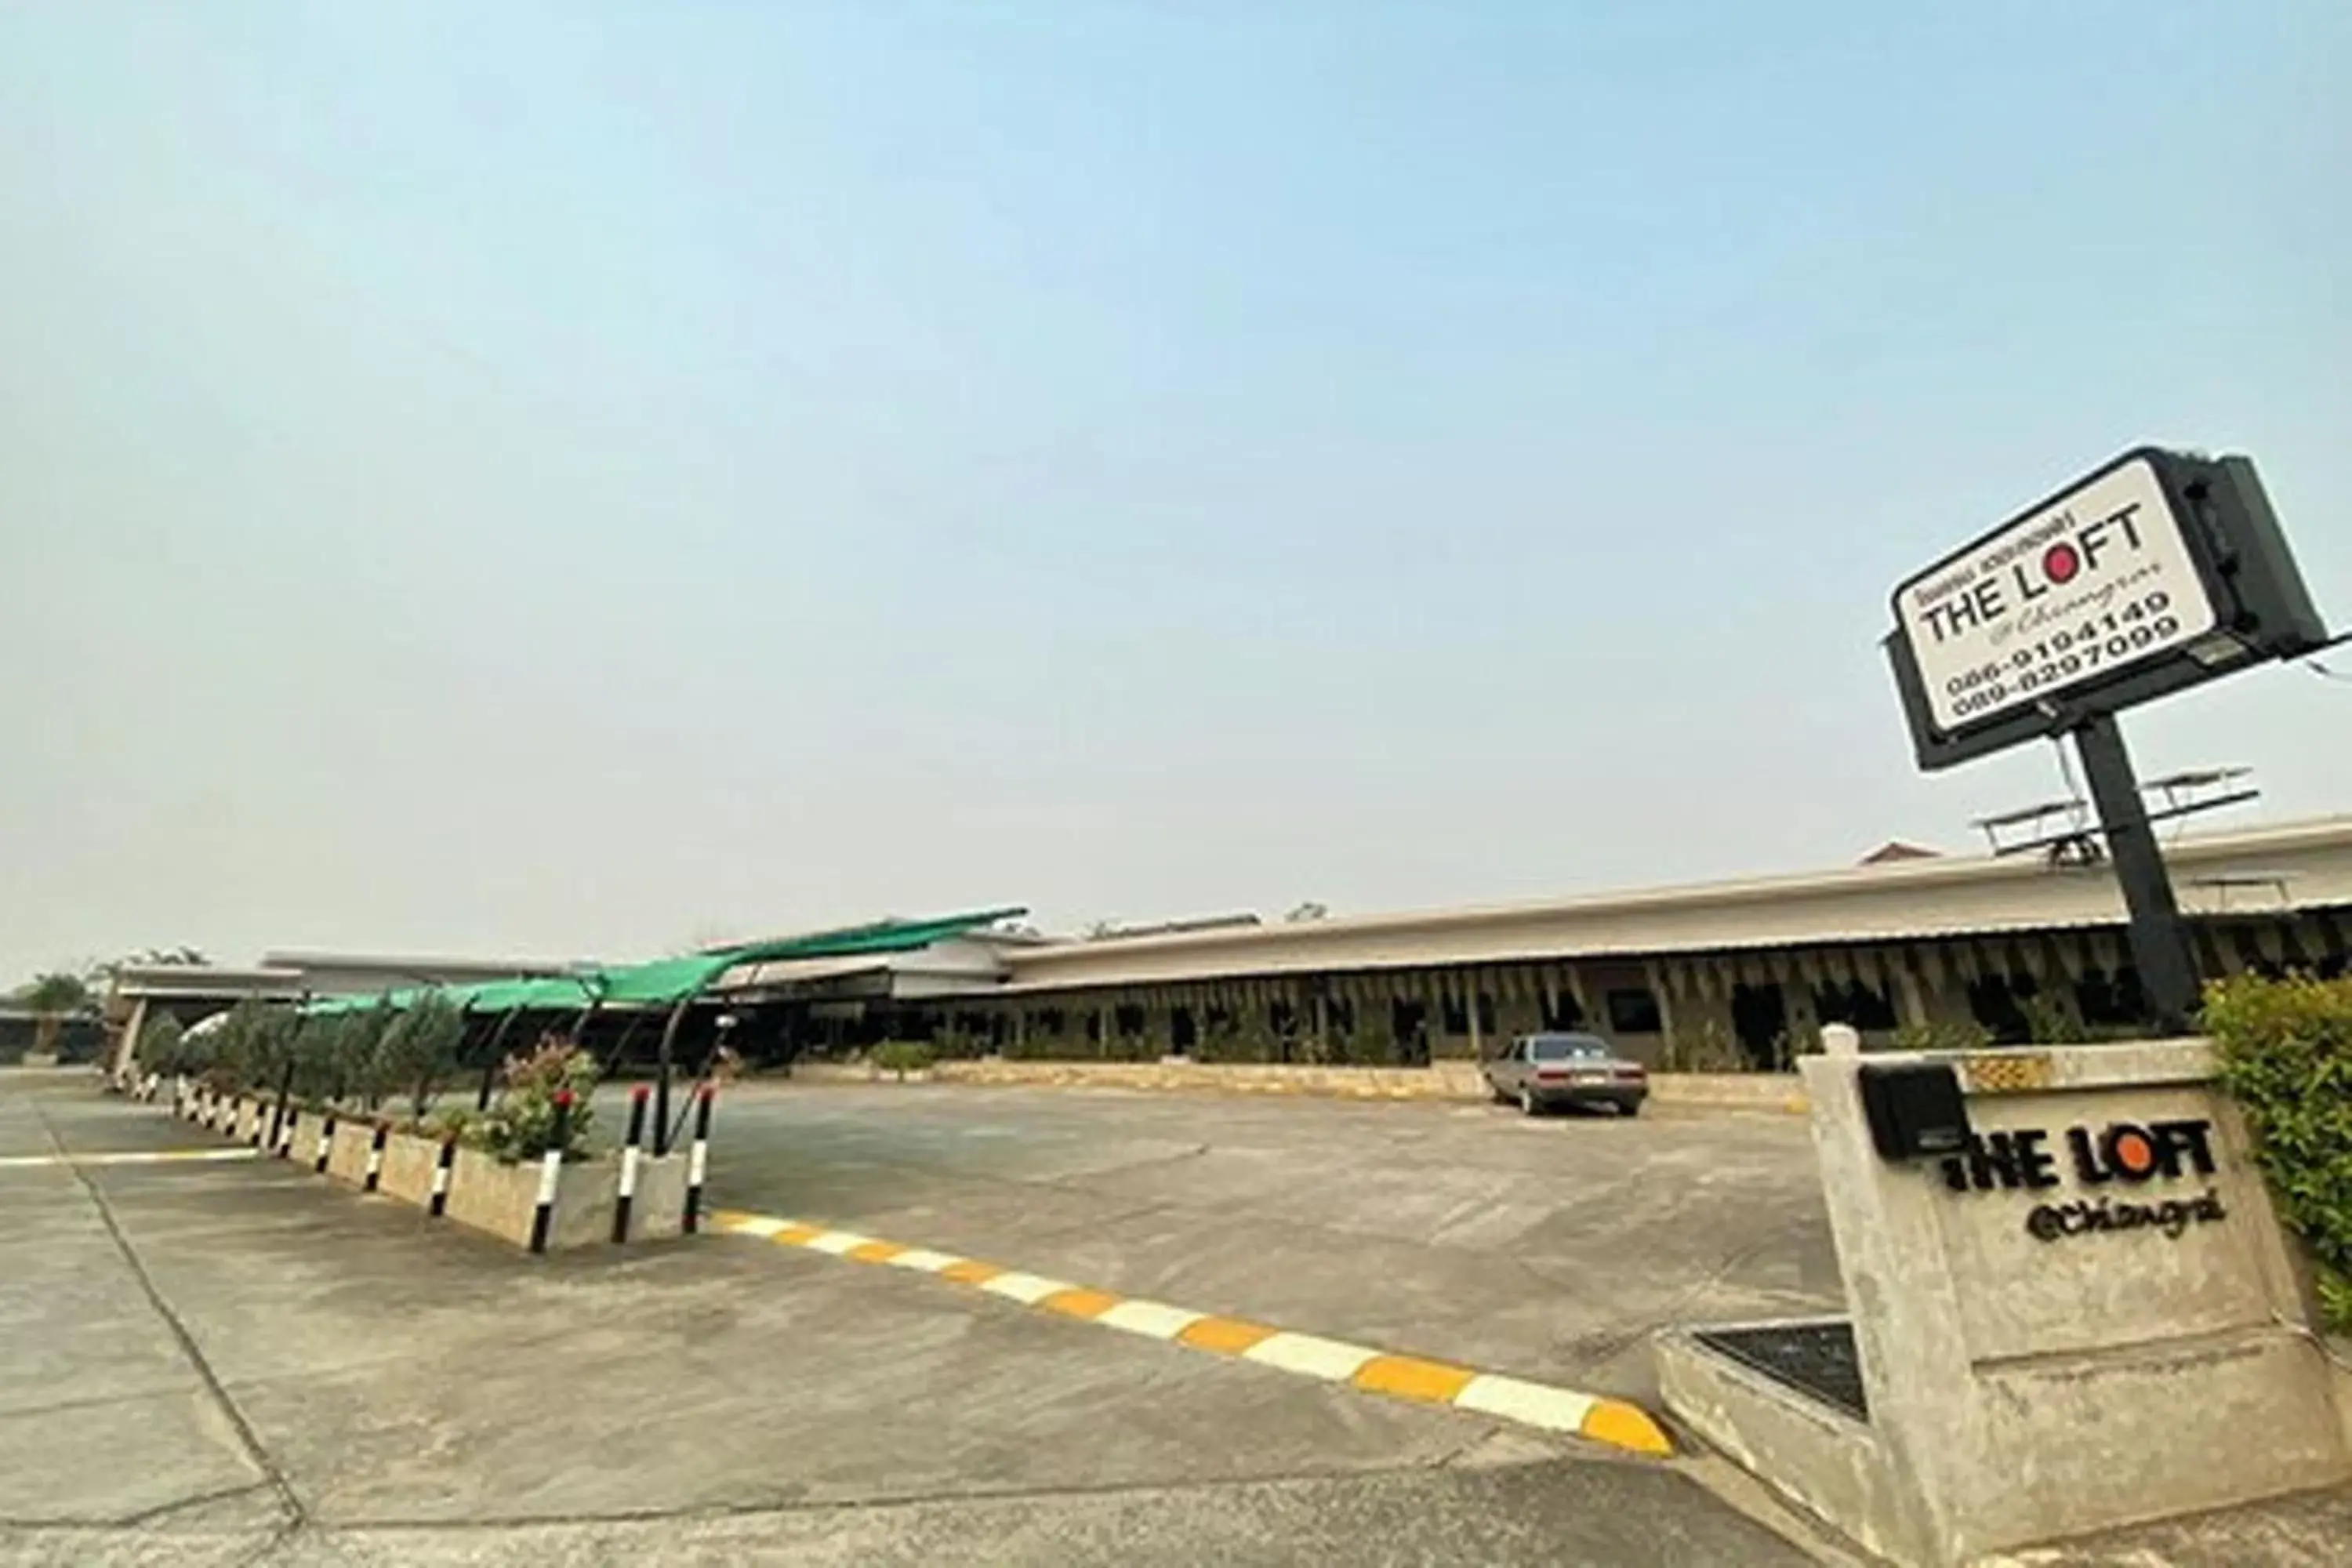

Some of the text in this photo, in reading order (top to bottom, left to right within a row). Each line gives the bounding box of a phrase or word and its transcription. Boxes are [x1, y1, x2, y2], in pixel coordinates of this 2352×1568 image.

[1919, 578, 2006, 643] THE
[2013, 503, 2141, 601] LOFT
[2066, 1120, 2216, 1185] LOFT
